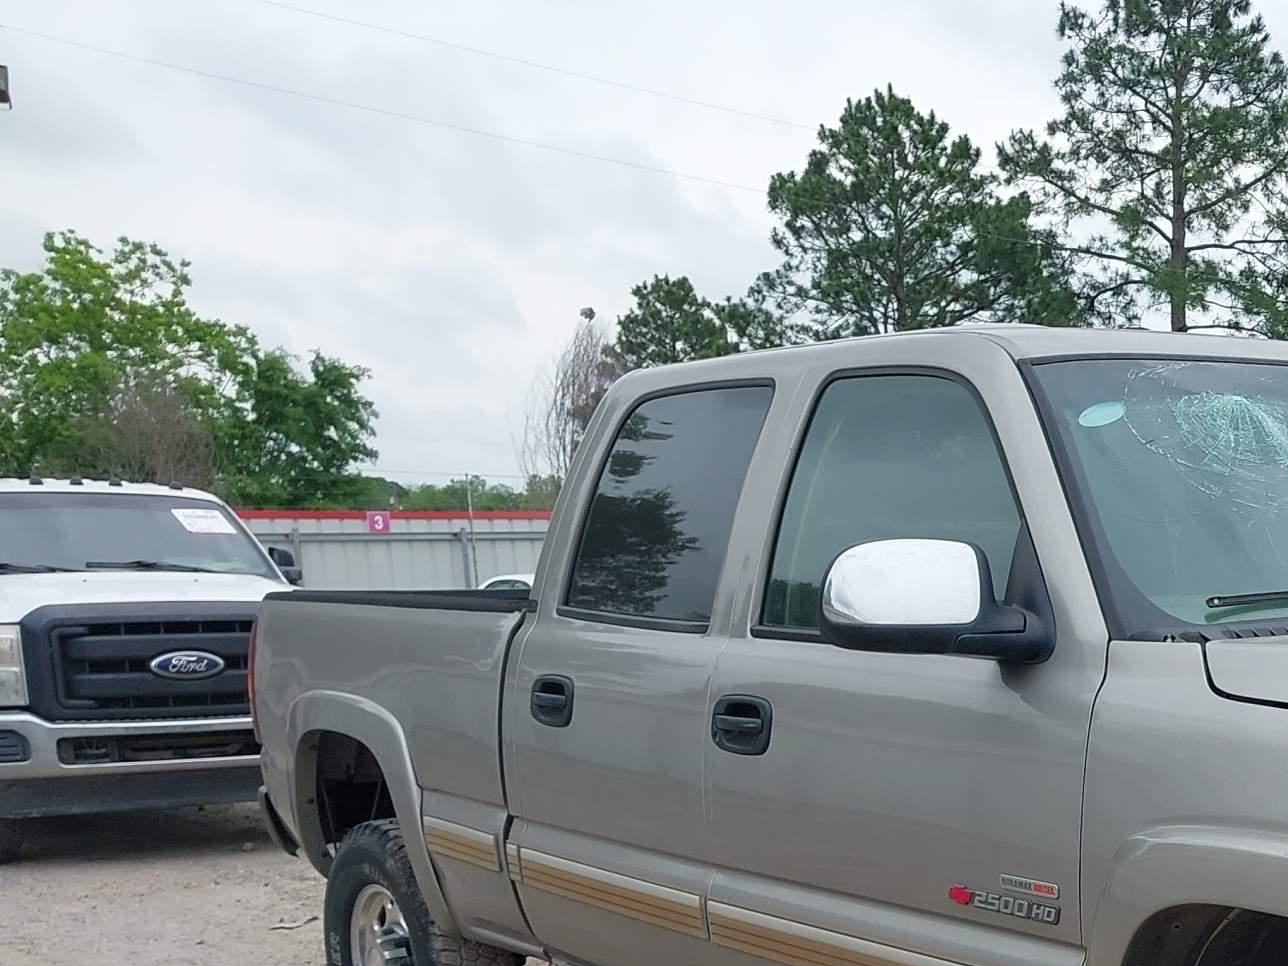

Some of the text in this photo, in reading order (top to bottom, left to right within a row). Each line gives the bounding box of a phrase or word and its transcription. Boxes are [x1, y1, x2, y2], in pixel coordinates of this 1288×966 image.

[374, 514, 385, 531] 3
[168, 655, 208, 673] Ford
[973, 890, 1057, 922] 2500 HD
